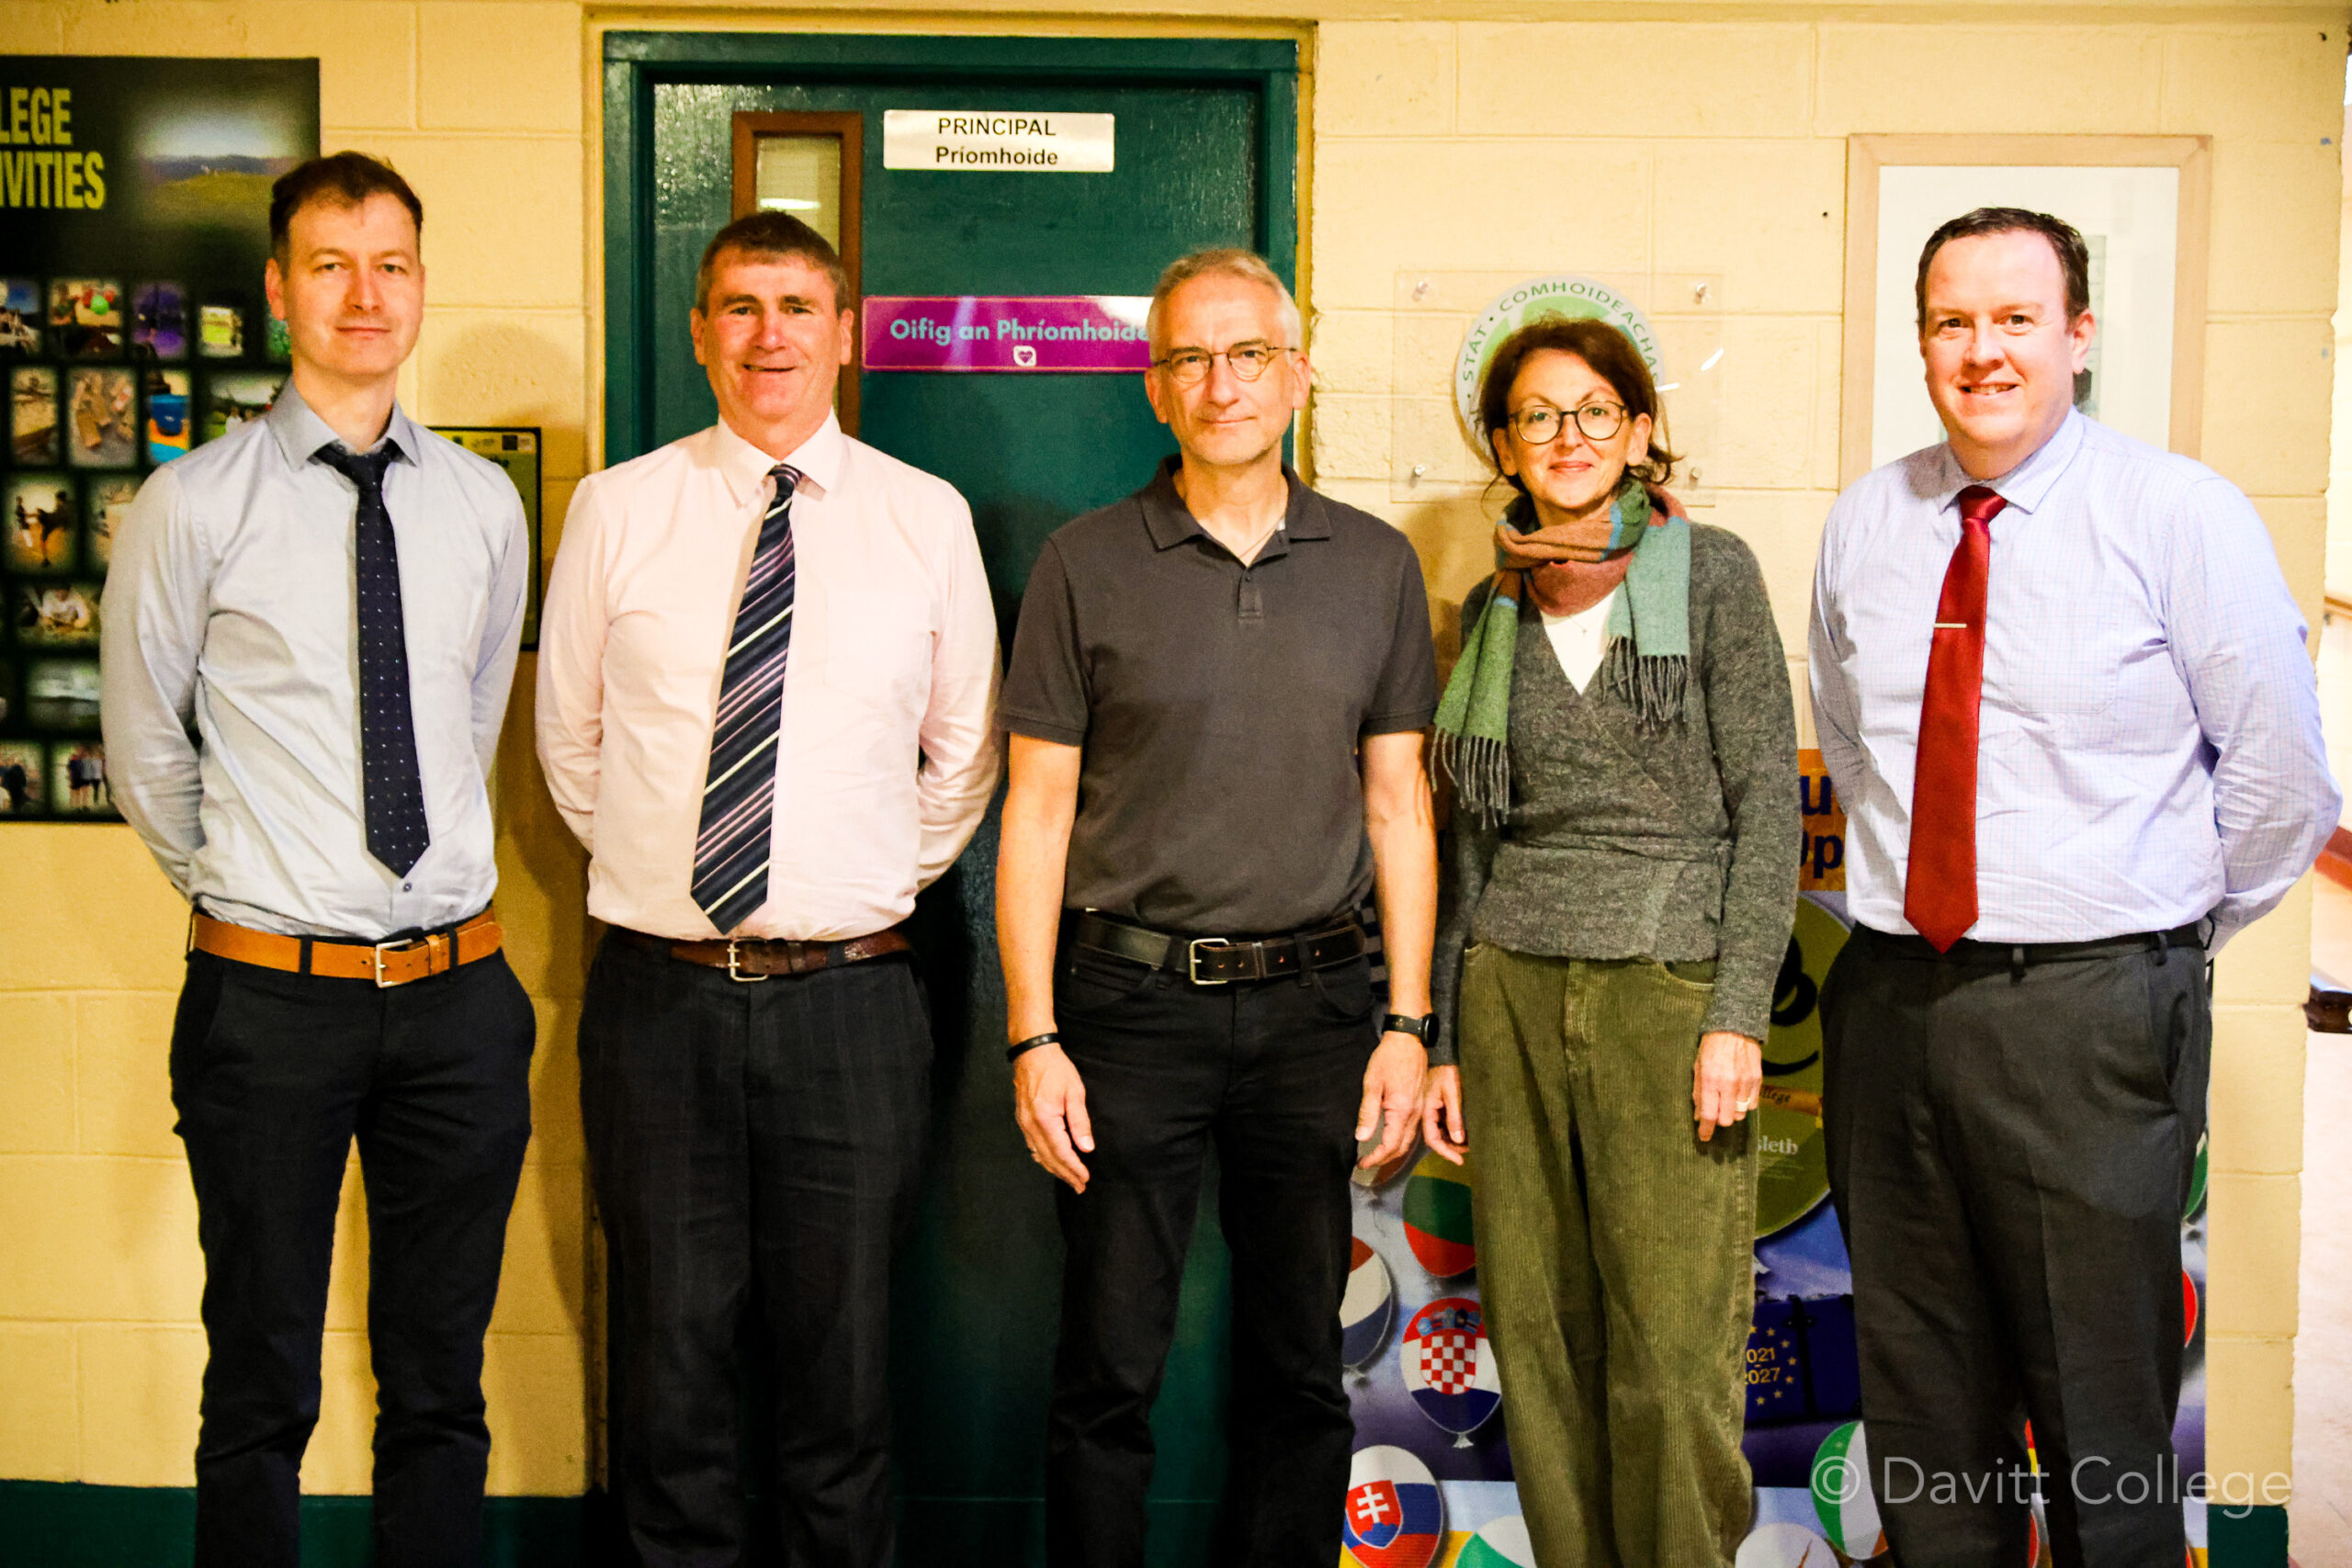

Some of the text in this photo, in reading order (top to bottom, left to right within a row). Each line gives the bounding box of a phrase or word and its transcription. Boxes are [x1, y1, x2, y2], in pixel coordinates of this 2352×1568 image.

[938, 118, 1057, 136] PRINCIPAL
[935, 145, 1058, 165] Príomhoide
[889, 317, 951, 346] Oifig
[958, 326, 990, 341] an
[1463, 324, 1487, 381] STAT
[1745, 1367, 1781, 1384] 027
